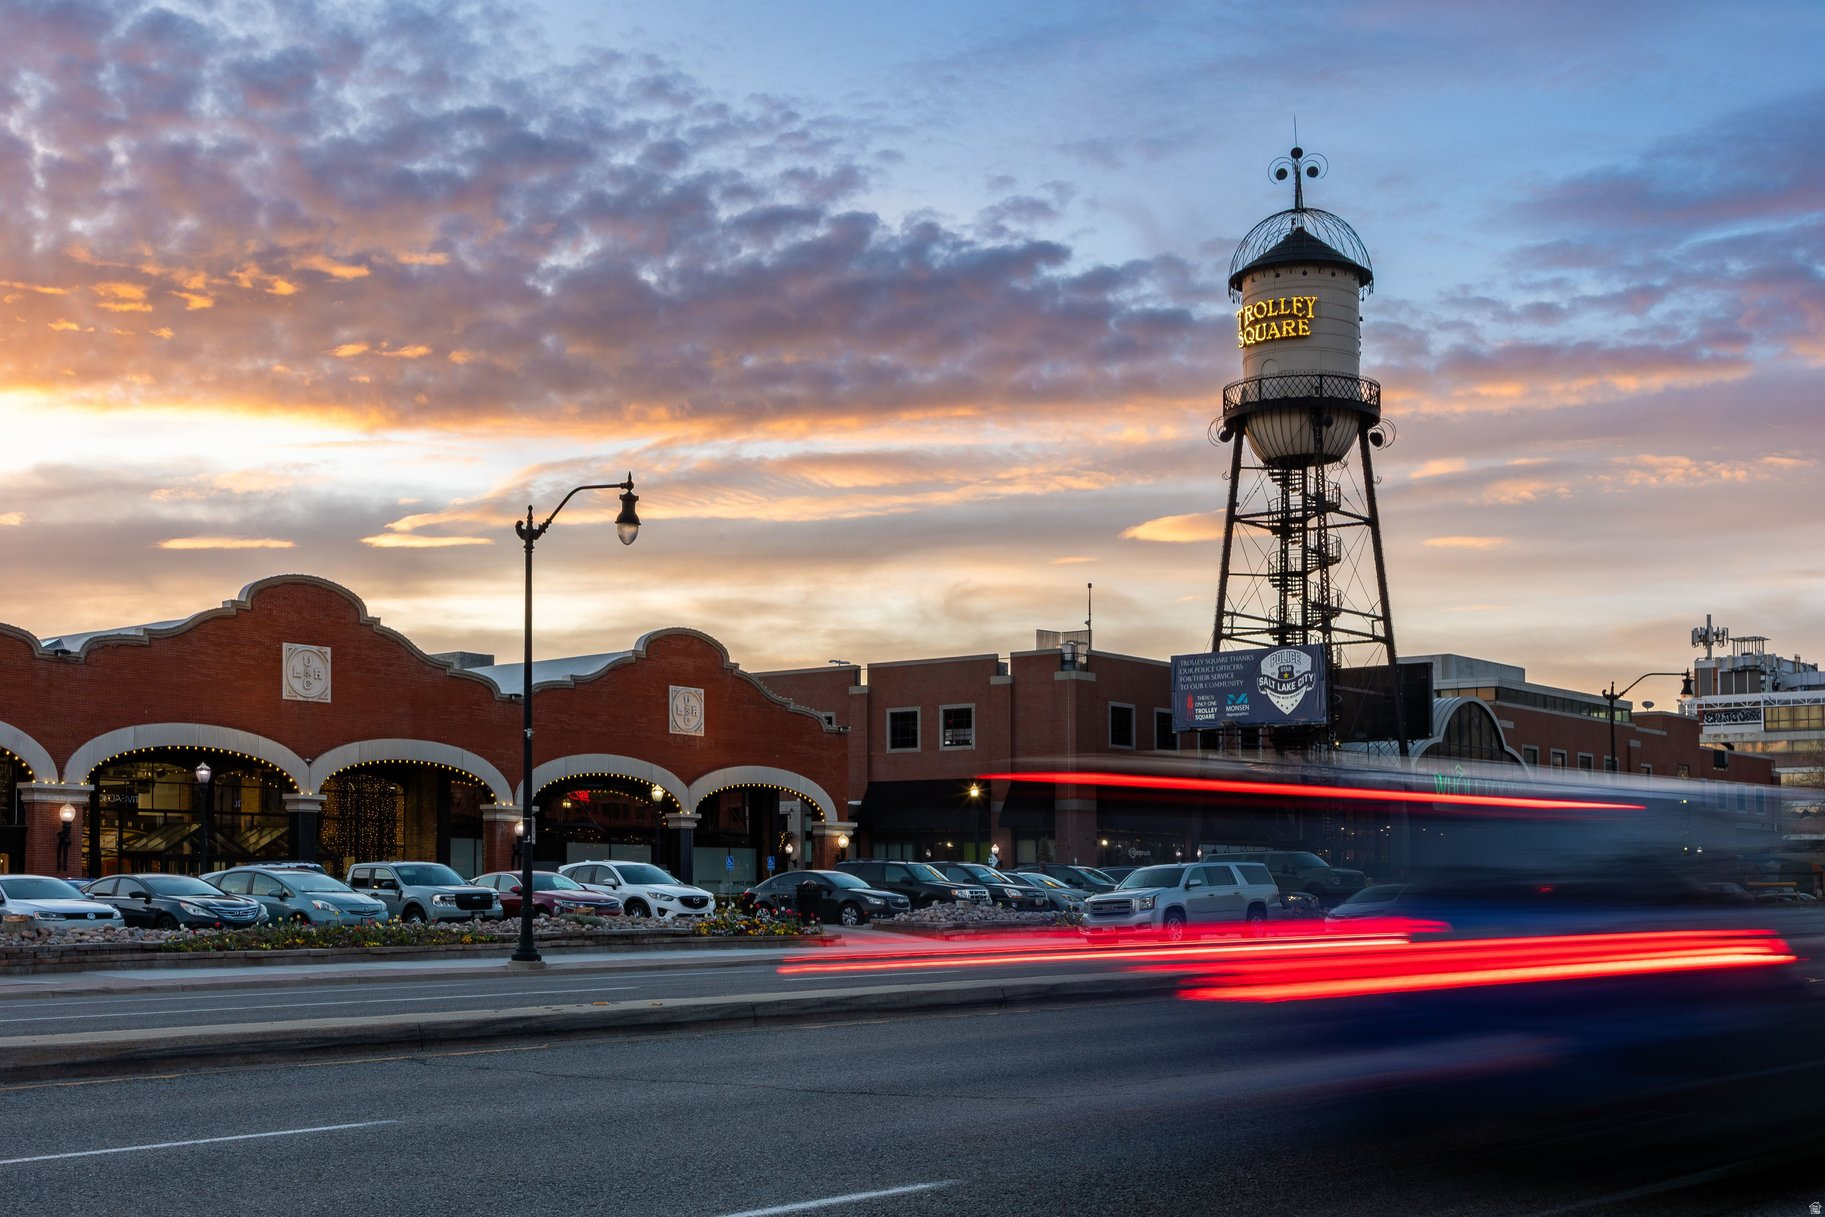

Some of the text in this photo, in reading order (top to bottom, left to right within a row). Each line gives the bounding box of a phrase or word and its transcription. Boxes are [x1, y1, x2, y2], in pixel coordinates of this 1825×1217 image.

[1236, 296, 1318, 330] TROLLEY
[1238, 319, 1311, 348] SQUARE
[1180, 654, 1254, 667] TROLLEY SQUARE THANKS
[1270, 651, 1301, 668] POLICE
[1180, 663, 1244, 675] OUR POLICE OFFICERS
[1193, 674, 1210, 682] THEIR
[1211, 672, 1234, 680] SERVICE
[1259, 673, 1313, 692] SALT LAKE CITY
[1190, 682, 1204, 690] OUR
[1204, 679, 1244, 689] COMMUNITY
[1226, 704, 1250, 712] MONSEN
